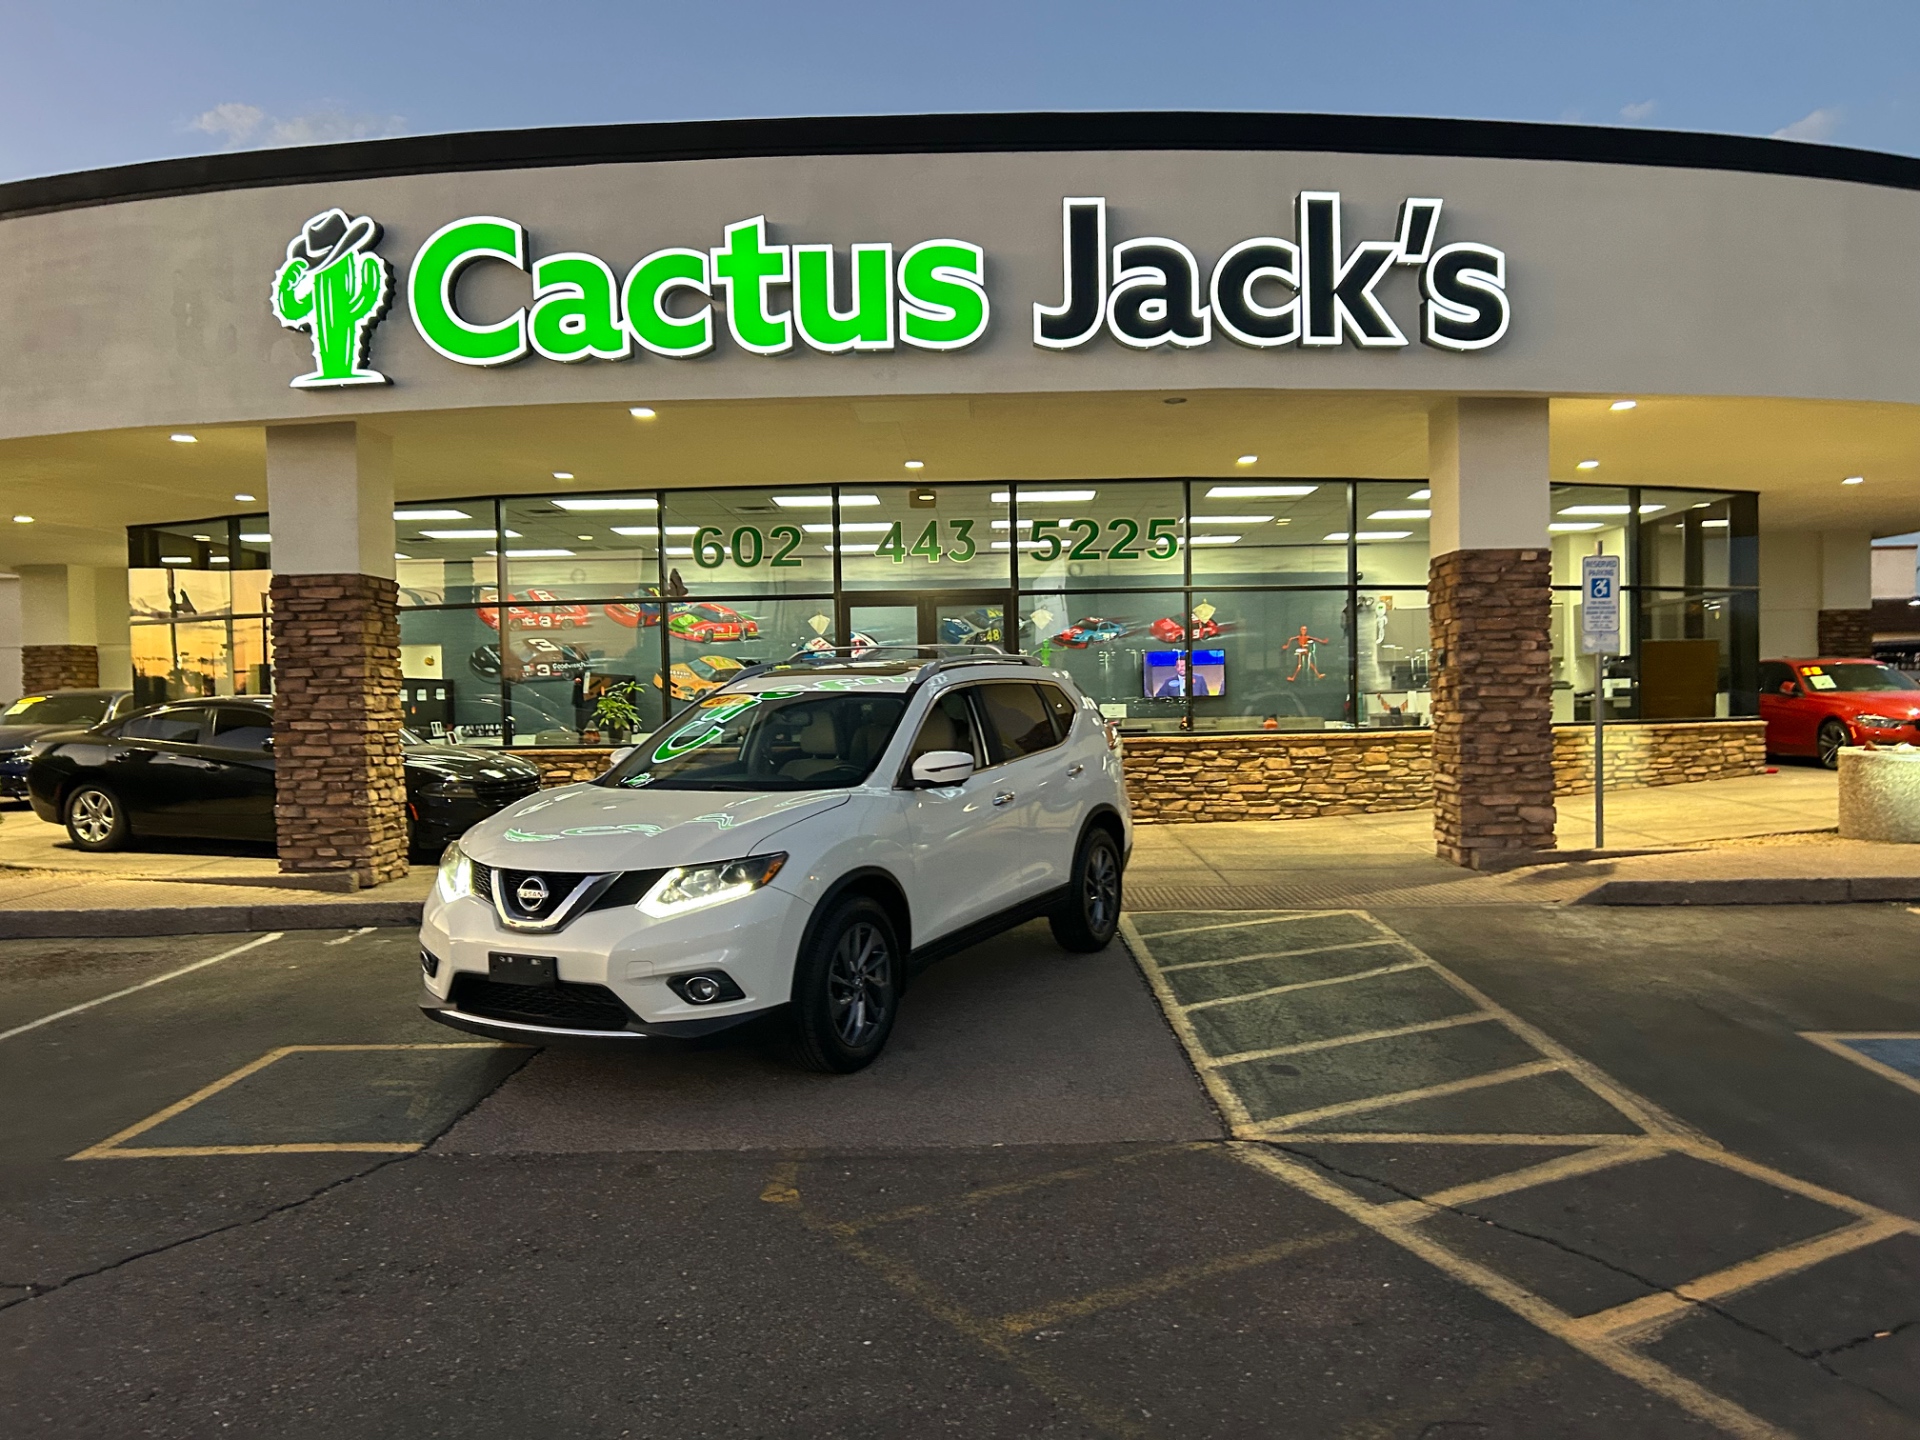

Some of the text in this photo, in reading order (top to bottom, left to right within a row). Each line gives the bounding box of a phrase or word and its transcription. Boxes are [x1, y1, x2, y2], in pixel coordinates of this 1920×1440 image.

[408, 190, 1511, 367] Cactus Jack's
[691, 518, 1180, 568] 602 443 5225
[1585, 560, 1617, 568] RESERVED
[1588, 569, 1614, 577] PARKING
[538, 615, 552, 628] 8
[986, 628, 1001, 642] 48
[527, 638, 560, 652] 3
[536, 664, 551, 676] 3
